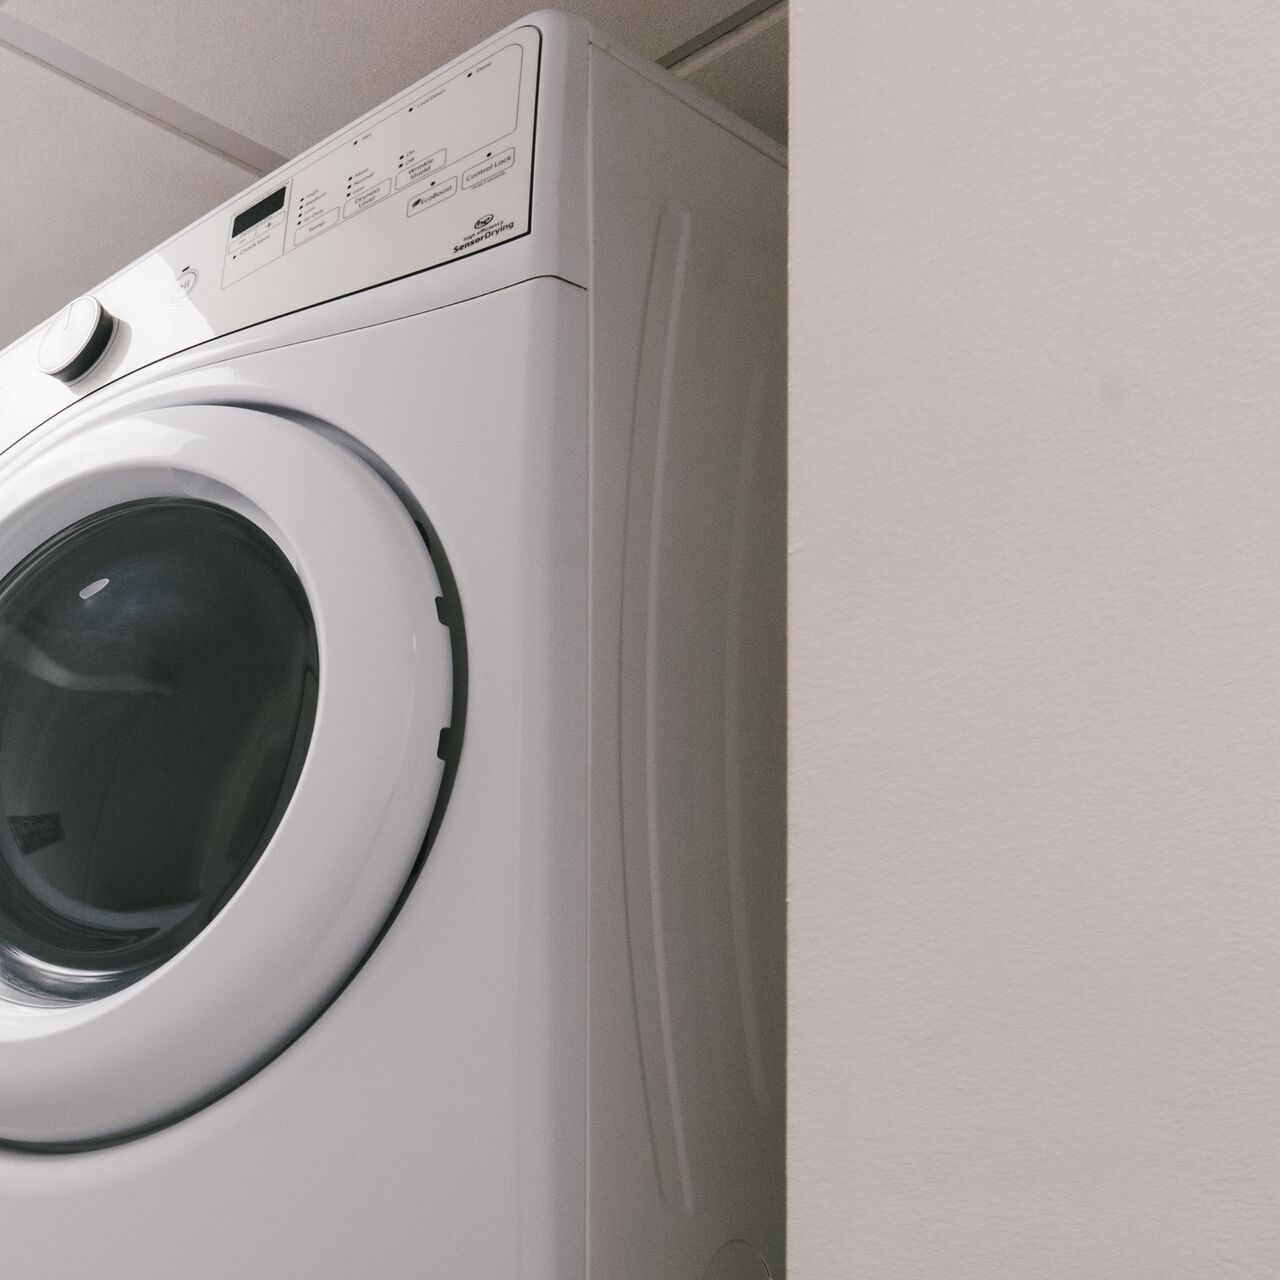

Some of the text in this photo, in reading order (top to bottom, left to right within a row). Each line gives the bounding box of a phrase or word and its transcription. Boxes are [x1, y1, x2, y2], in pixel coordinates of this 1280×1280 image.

[466, 165, 493, 181] Control
[494, 155, 512, 168] Lock
[453, 221, 514, 254] SensorDrying
